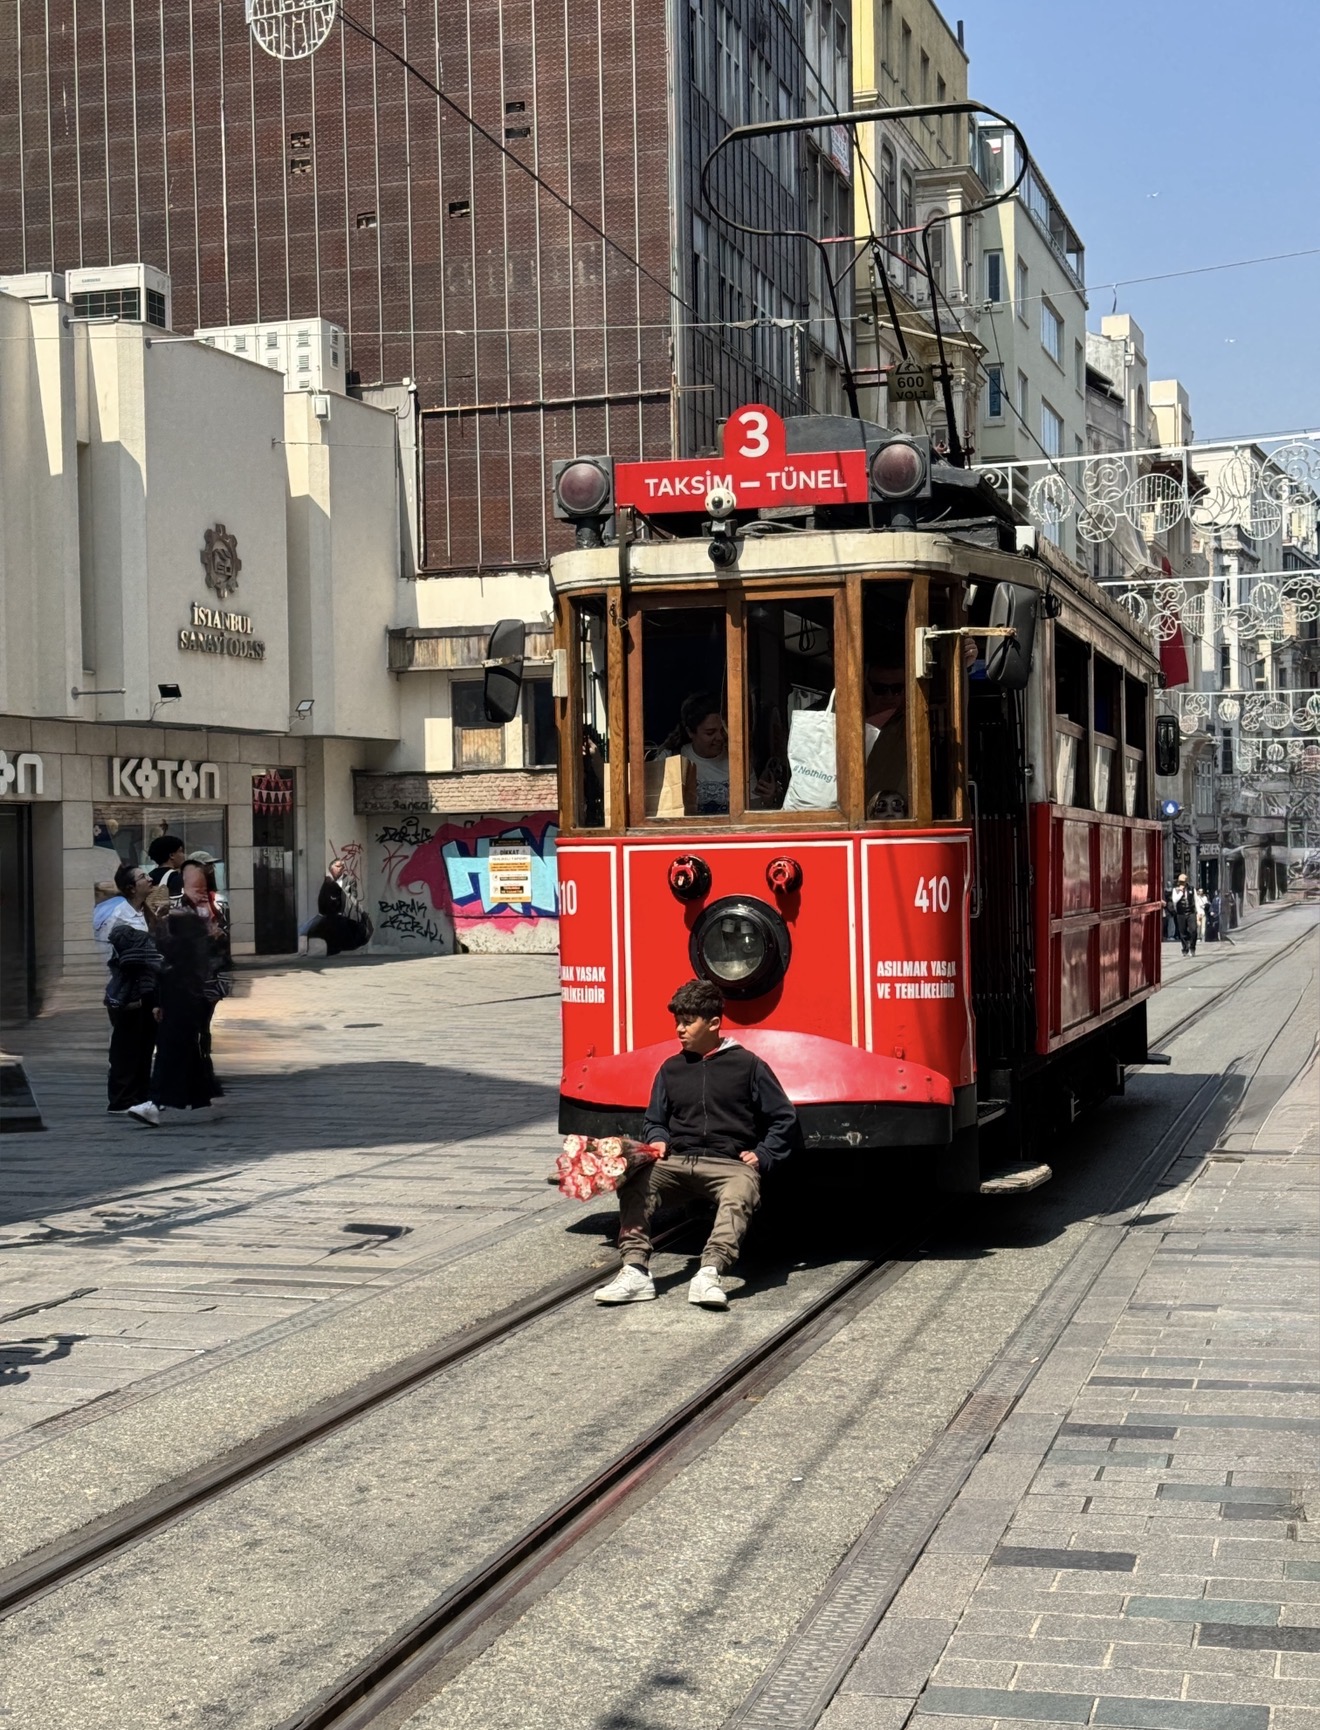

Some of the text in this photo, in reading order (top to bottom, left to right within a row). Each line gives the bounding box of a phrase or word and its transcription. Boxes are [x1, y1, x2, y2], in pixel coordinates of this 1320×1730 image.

[897, 376, 924, 389] 600
[896, 390, 928, 400] VOLT
[738, 411, 770, 458] 3
[644, 470, 734, 497] TAKSİM
[766, 466, 847, 491] TÜNEL
[193, 601, 256, 634] İSTANBUL
[179, 630, 228, 655] SANAYİ
[914, 875, 951, 914] 410
[575, 966, 606, 982] YASAK
[876, 960, 957, 978] ASILMAK YASAK
[876, 980, 955, 999] VE TEHLİKELİDİR
